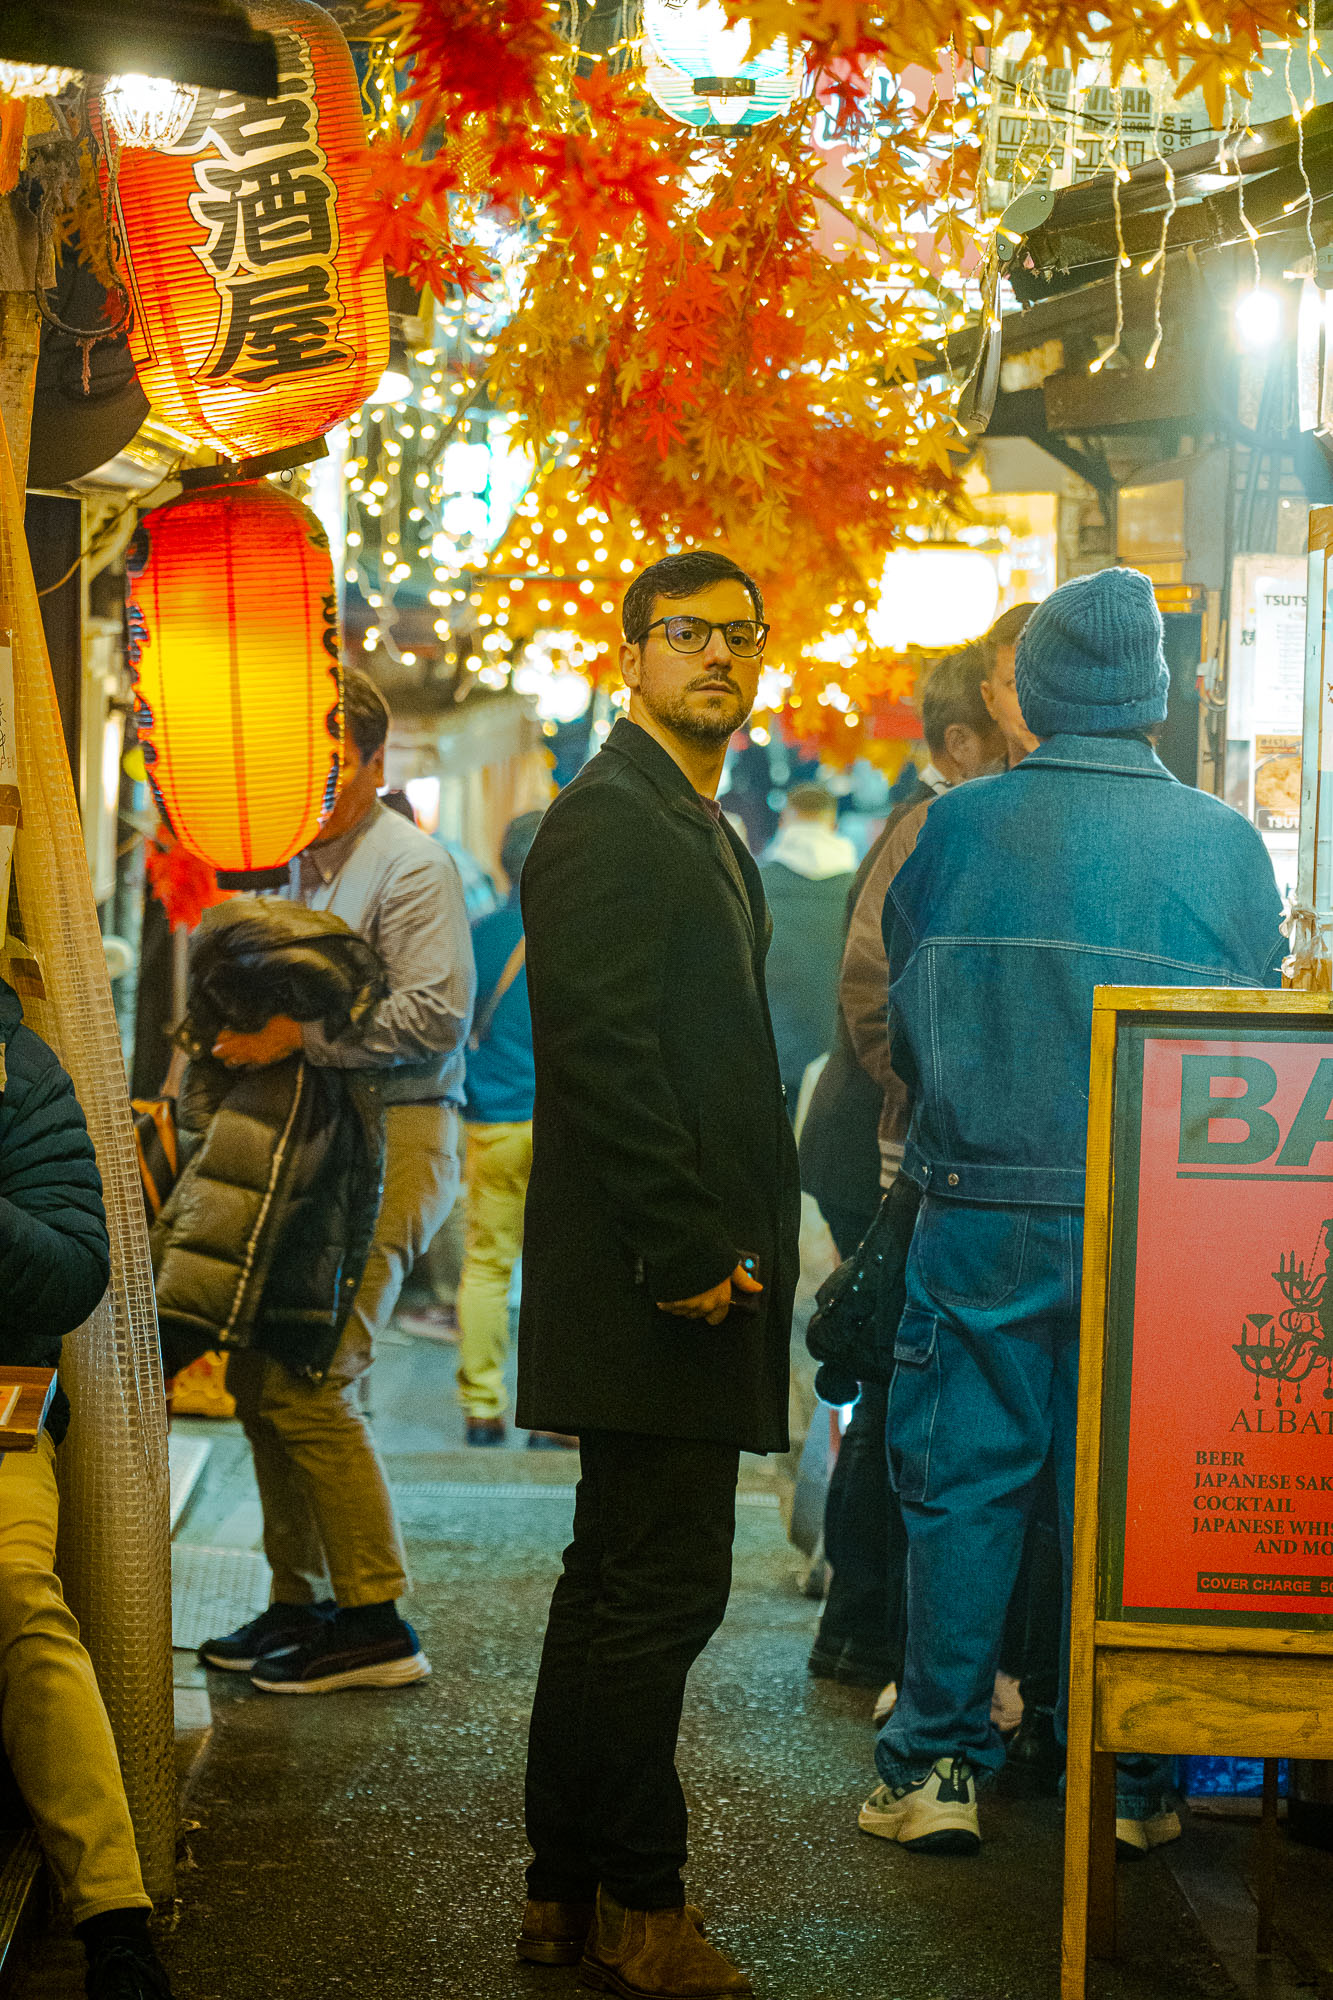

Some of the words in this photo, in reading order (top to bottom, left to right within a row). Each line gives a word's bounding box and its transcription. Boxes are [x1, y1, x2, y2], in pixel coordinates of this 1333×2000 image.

[1195, 1450, 1245, 1467] BEER
[1194, 1472, 1291, 1490] JAPANESE
[1295, 1475, 1333, 1491] SAK
[1193, 1495, 1296, 1513] COCKTAIL
[1192, 1517, 1285, 1535] JAPANESE
[1254, 1538, 1298, 1555] AND
[1303, 1540, 1333, 1556] MO
[1200, 1577, 1249, 1590] COVER
[1252, 1579, 1311, 1592] CHARGE
